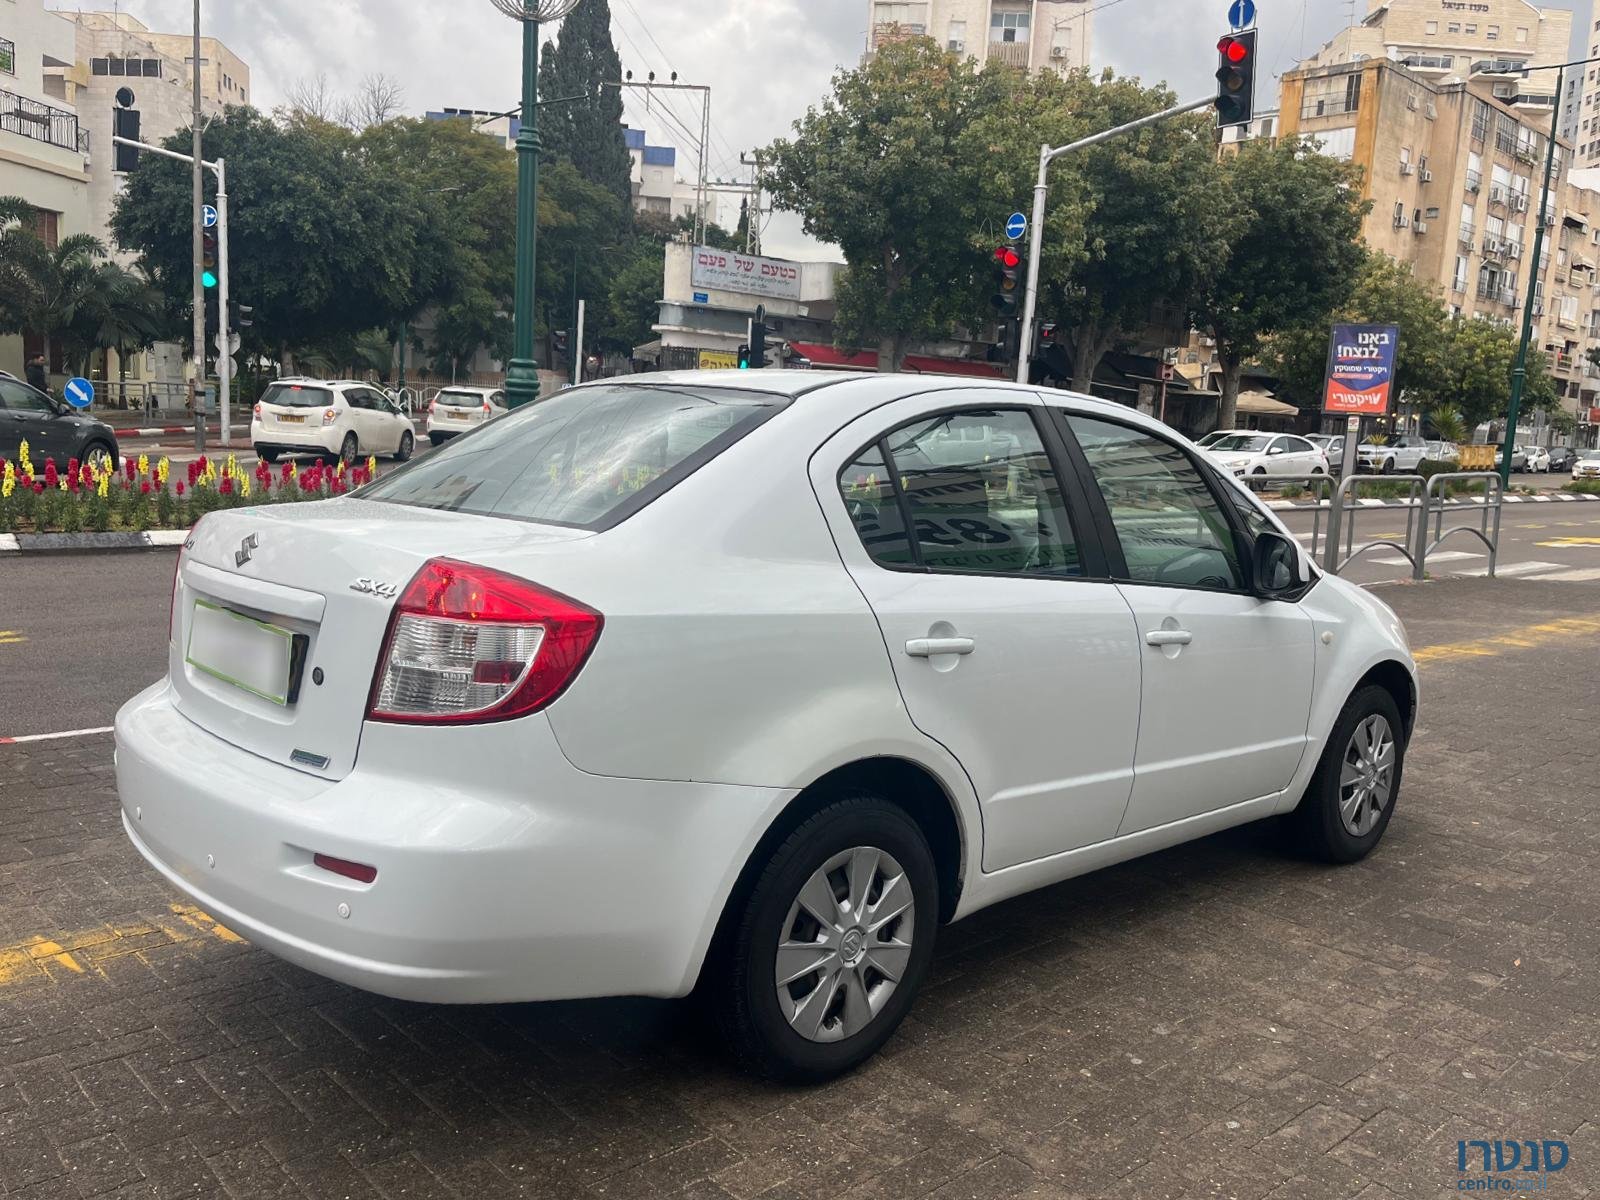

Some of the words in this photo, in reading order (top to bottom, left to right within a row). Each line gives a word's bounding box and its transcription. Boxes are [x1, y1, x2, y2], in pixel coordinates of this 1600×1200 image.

[698, 253, 727, 268] פעם
[734, 255, 755, 273] של
[761, 263, 797, 279] בטעם
[1358, 333, 1389, 344] באנו
[1337, 345, 1379, 358] לנצח!
[349, 577, 398, 600] SX4
